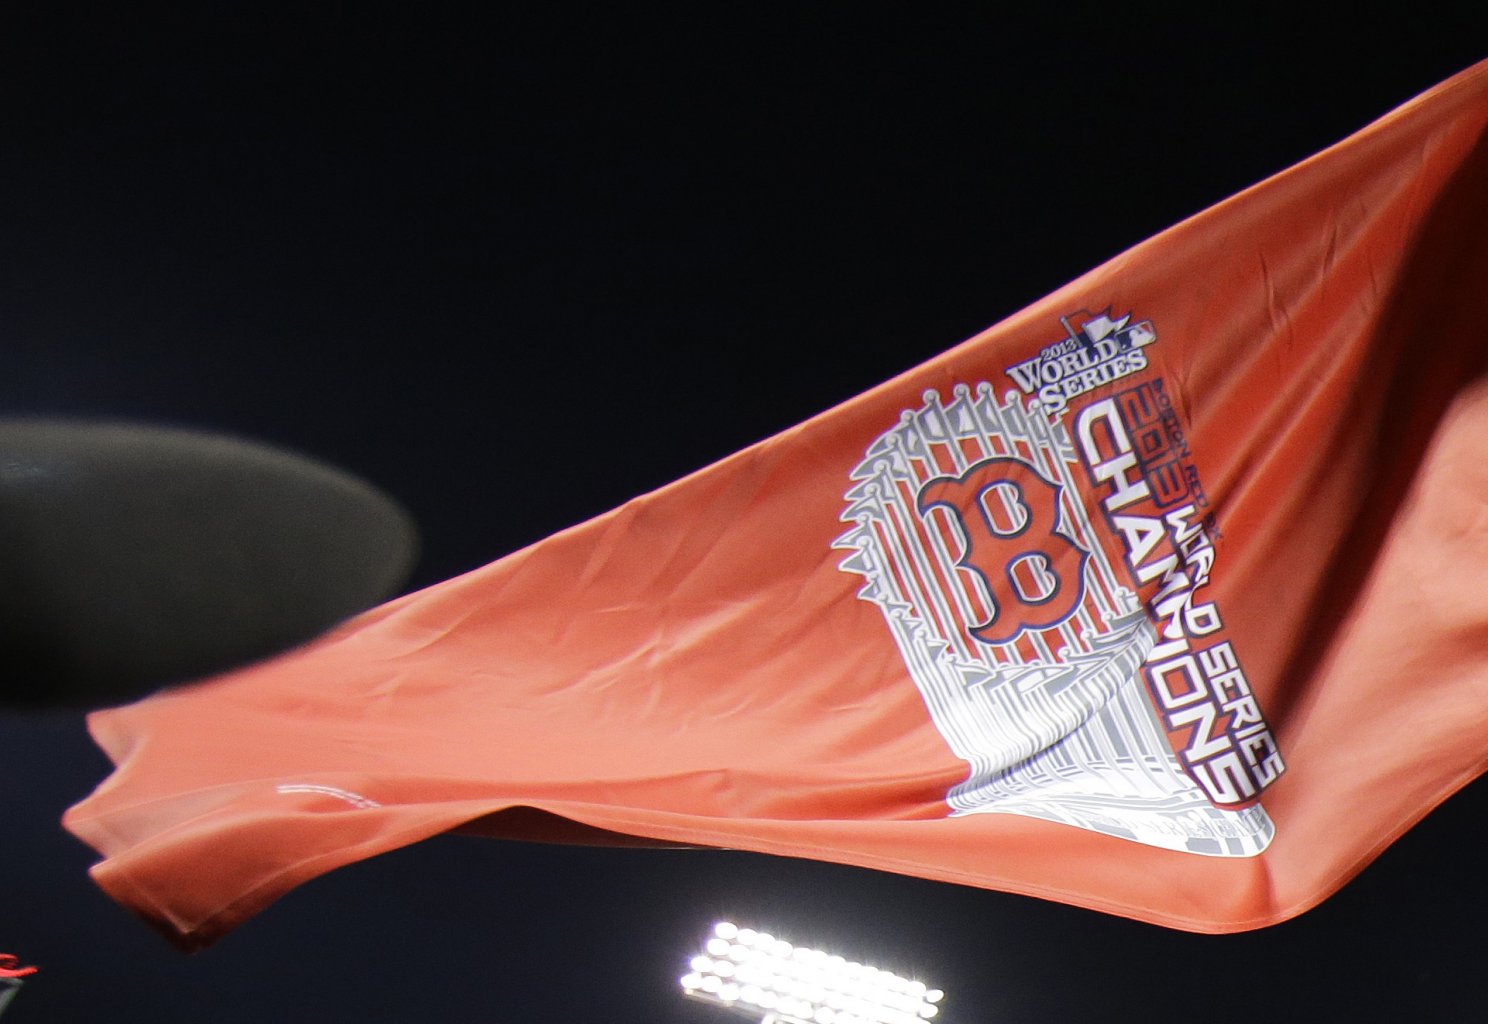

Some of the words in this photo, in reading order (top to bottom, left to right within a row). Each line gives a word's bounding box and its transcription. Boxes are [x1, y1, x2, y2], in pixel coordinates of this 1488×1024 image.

[1005, 339, 1118, 394] WORLD
[1039, 348, 1148, 415] SERIES
[1041, 339, 1077, 361] 2013
[917, 457, 1090, 646] B
[1198, 641, 1286, 788] SERIES
